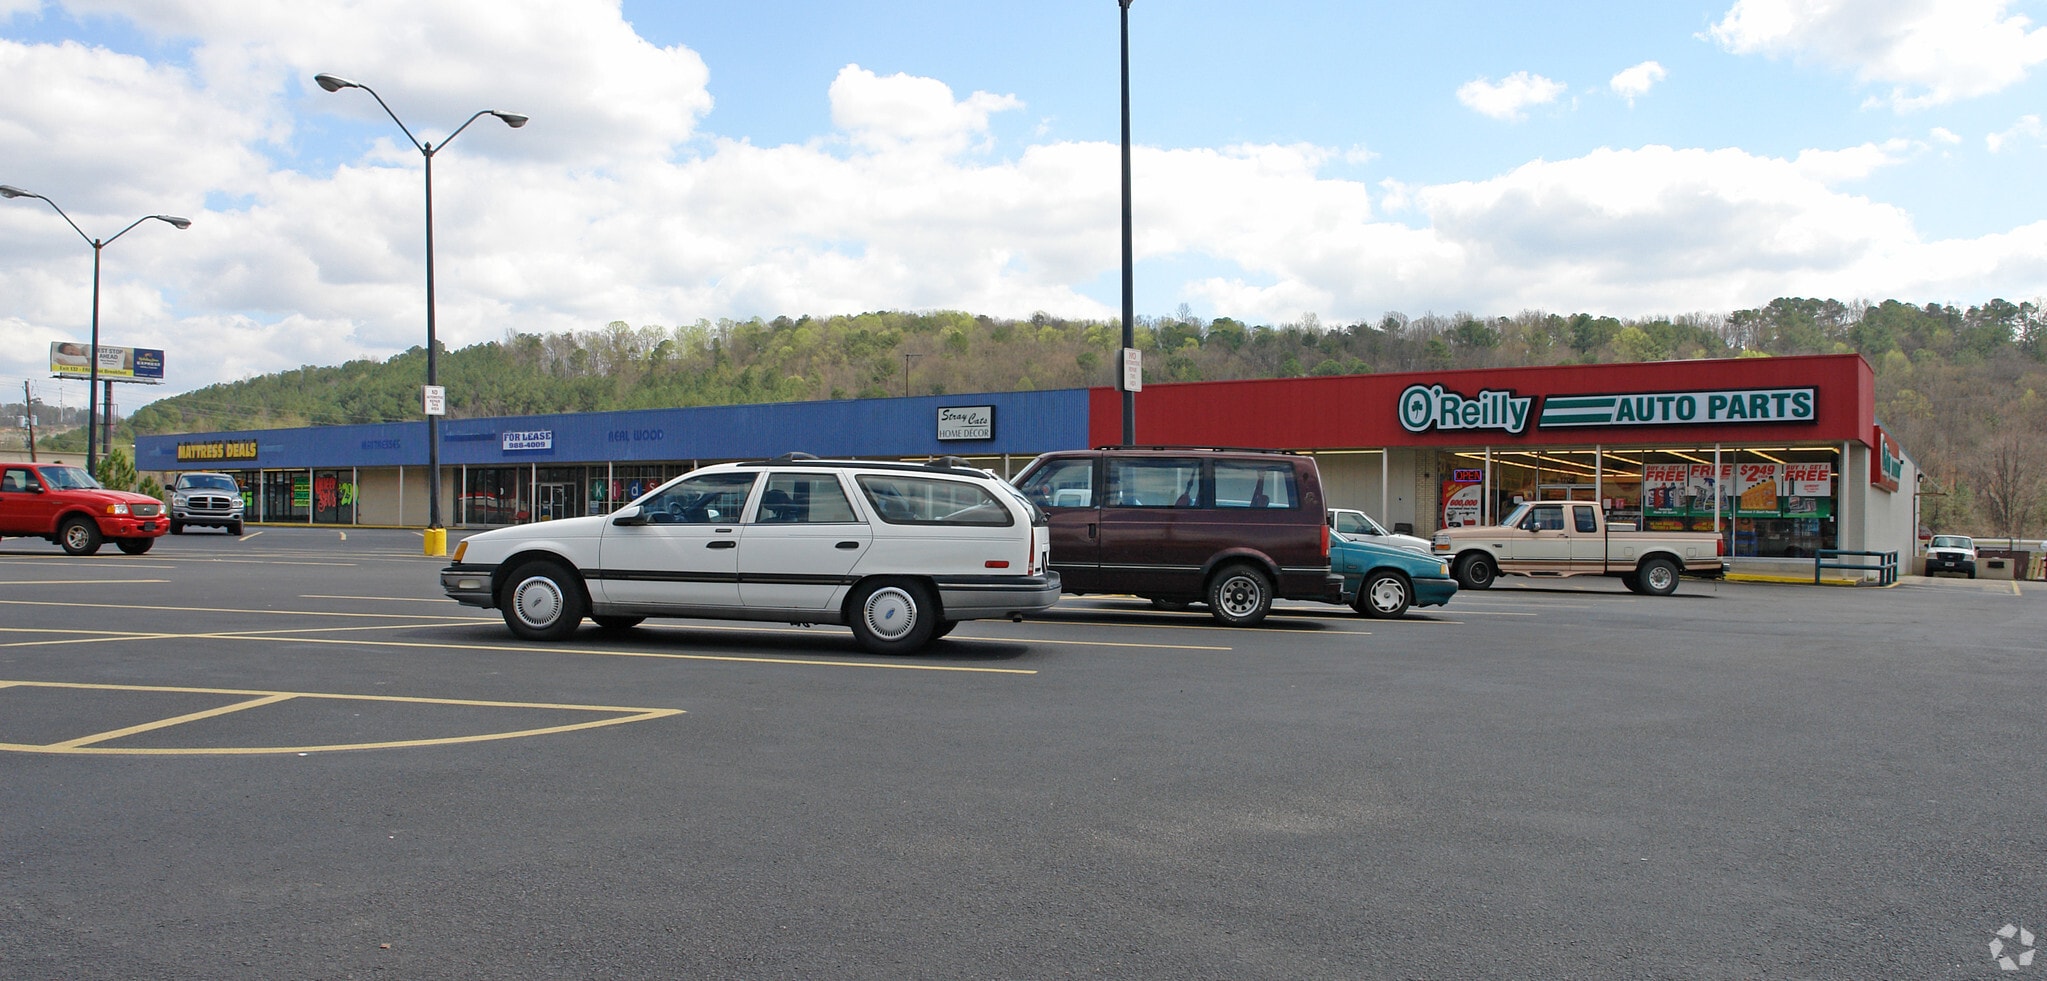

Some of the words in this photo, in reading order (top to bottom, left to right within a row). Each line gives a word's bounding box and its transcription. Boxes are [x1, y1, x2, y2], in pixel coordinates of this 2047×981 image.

[1128, 352, 1136, 360] NO
[1402, 388, 1528, 430] O'Reilly
[1616, 395, 1696, 421] AUTO
[1708, 392, 1811, 420] PARTS
[941, 409, 968, 422] Stray
[968, 412, 988, 425] Cats
[503, 433, 521, 441] FOR
[522, 432, 551, 441] LEASE
[608, 430, 630, 442] REAL
[633, 429, 664, 441] WOOD
[939, 429, 962, 438] HOME
[963, 428, 989, 438] DÉCOR
[177, 443, 224, 459] MATTRESS
[225, 442, 257, 458] DEALS
[508, 441, 546, 449] 988-4009
[1456, 471, 1480, 480] OPEN
[1645, 471, 1687, 482] FREE
[1784, 470, 1829, 482] FREE
